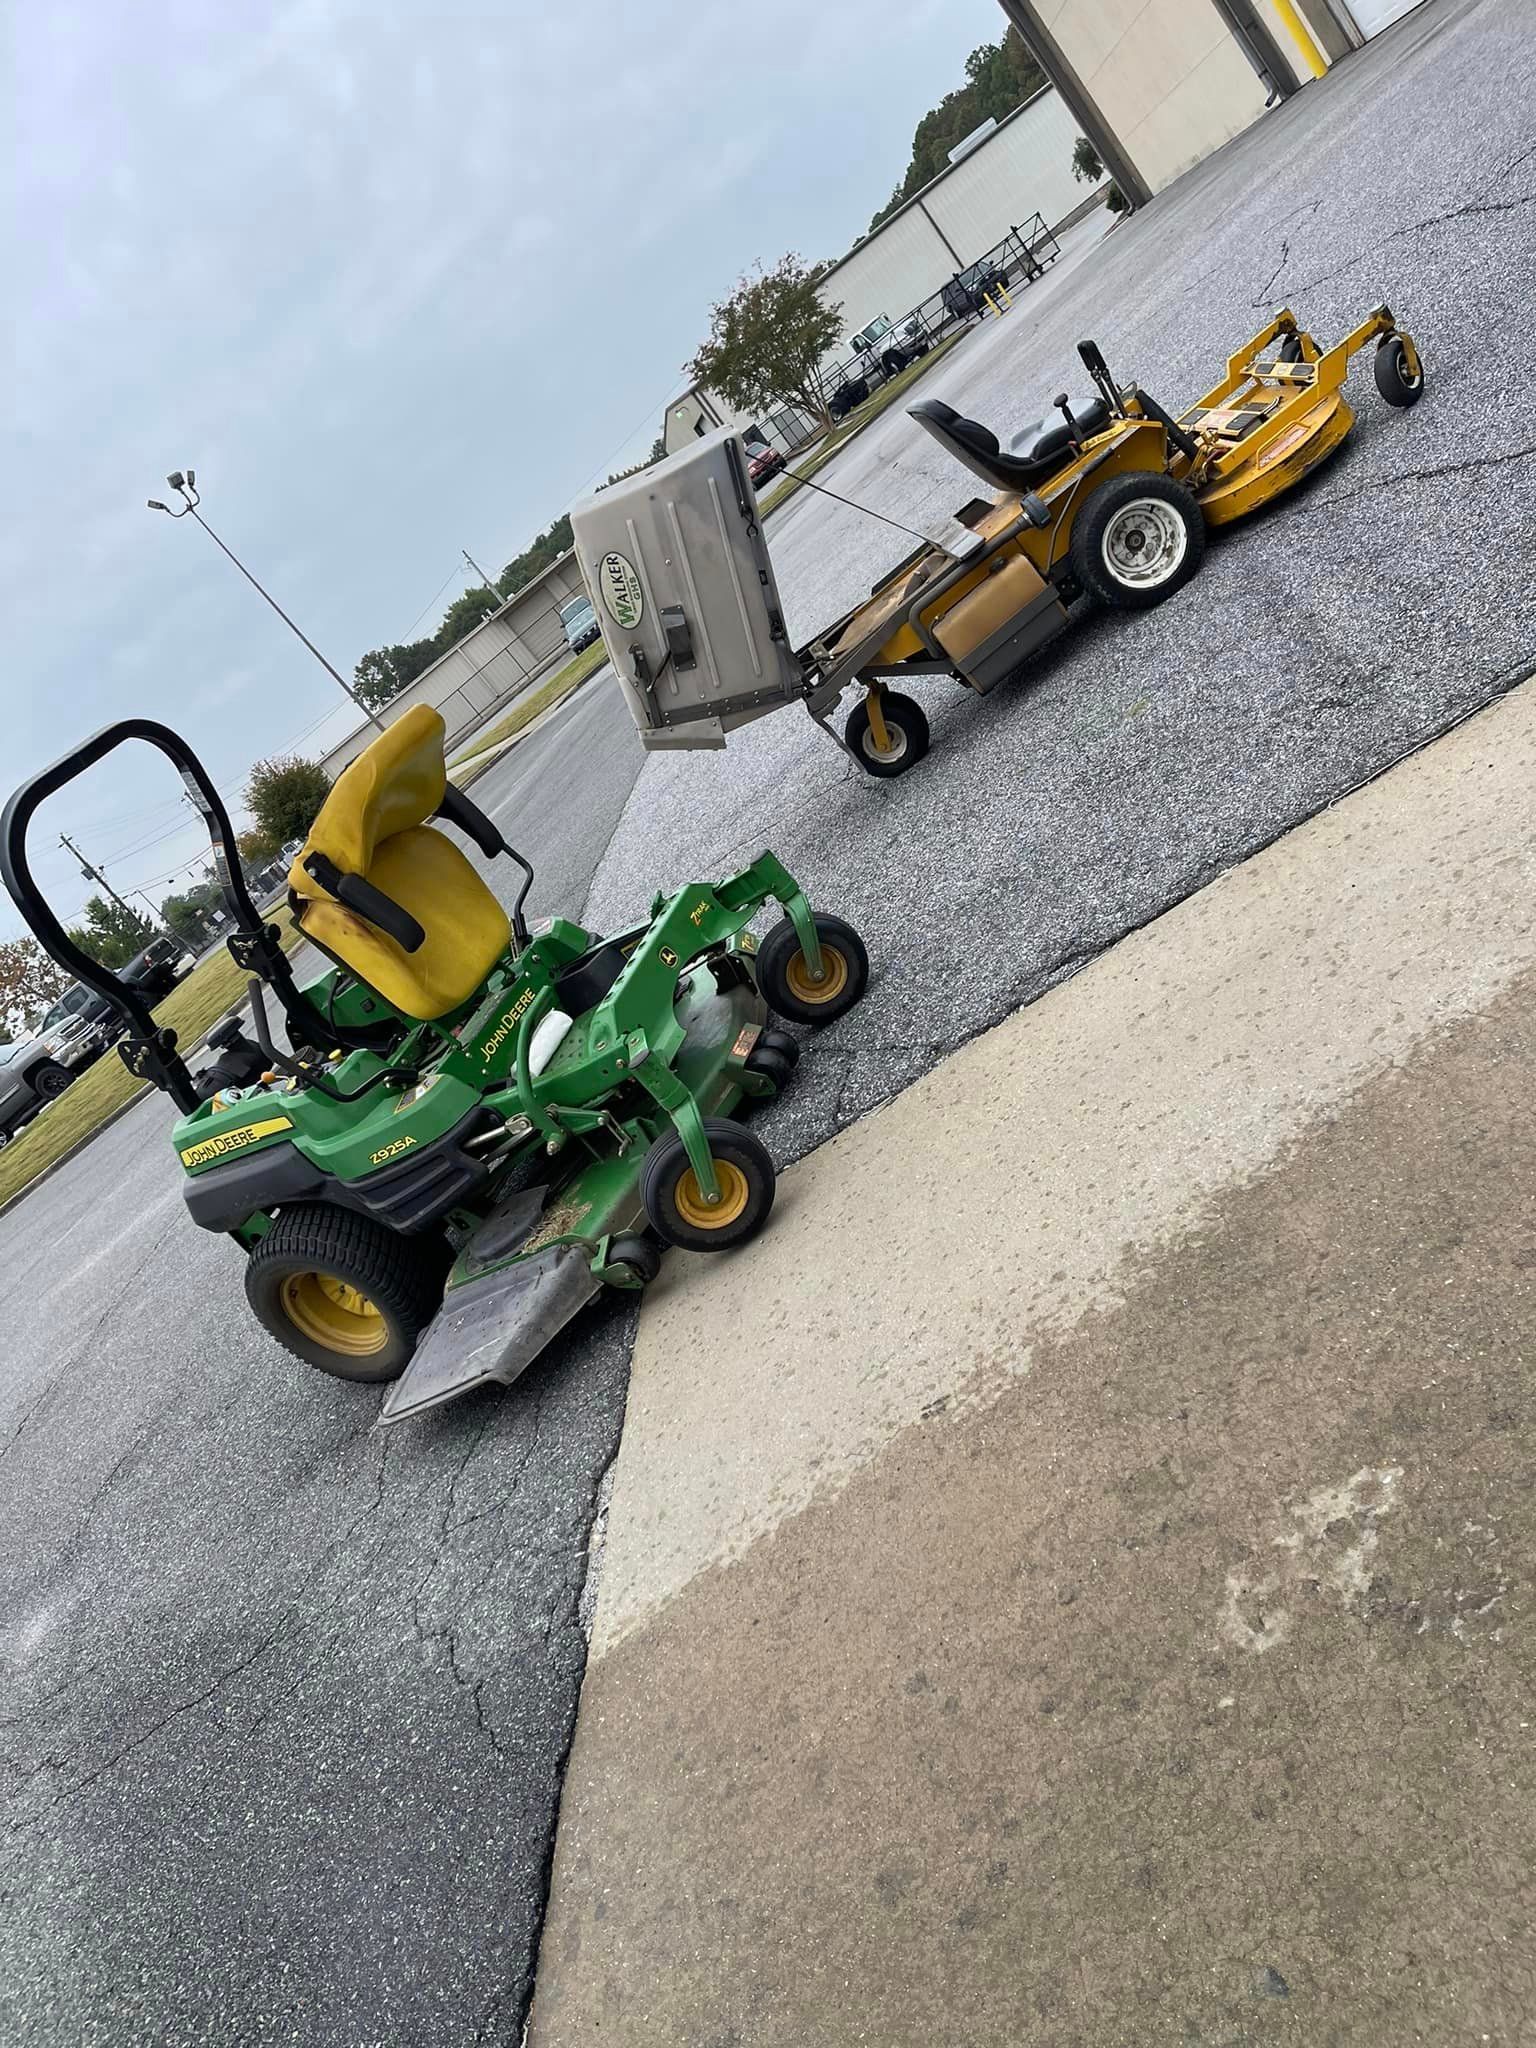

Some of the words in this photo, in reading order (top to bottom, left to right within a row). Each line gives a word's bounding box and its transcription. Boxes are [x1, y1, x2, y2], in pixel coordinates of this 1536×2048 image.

[607, 556, 635, 624] WALKER
[629, 576, 641, 600] GHS
[480, 1024, 508, 1063] JOHN
[501, 987, 536, 1029] DEERE
[186, 1144, 216, 1165] JOHN
[214, 1129, 257, 1153] DEERE
[369, 1136, 417, 1164] Z925A
